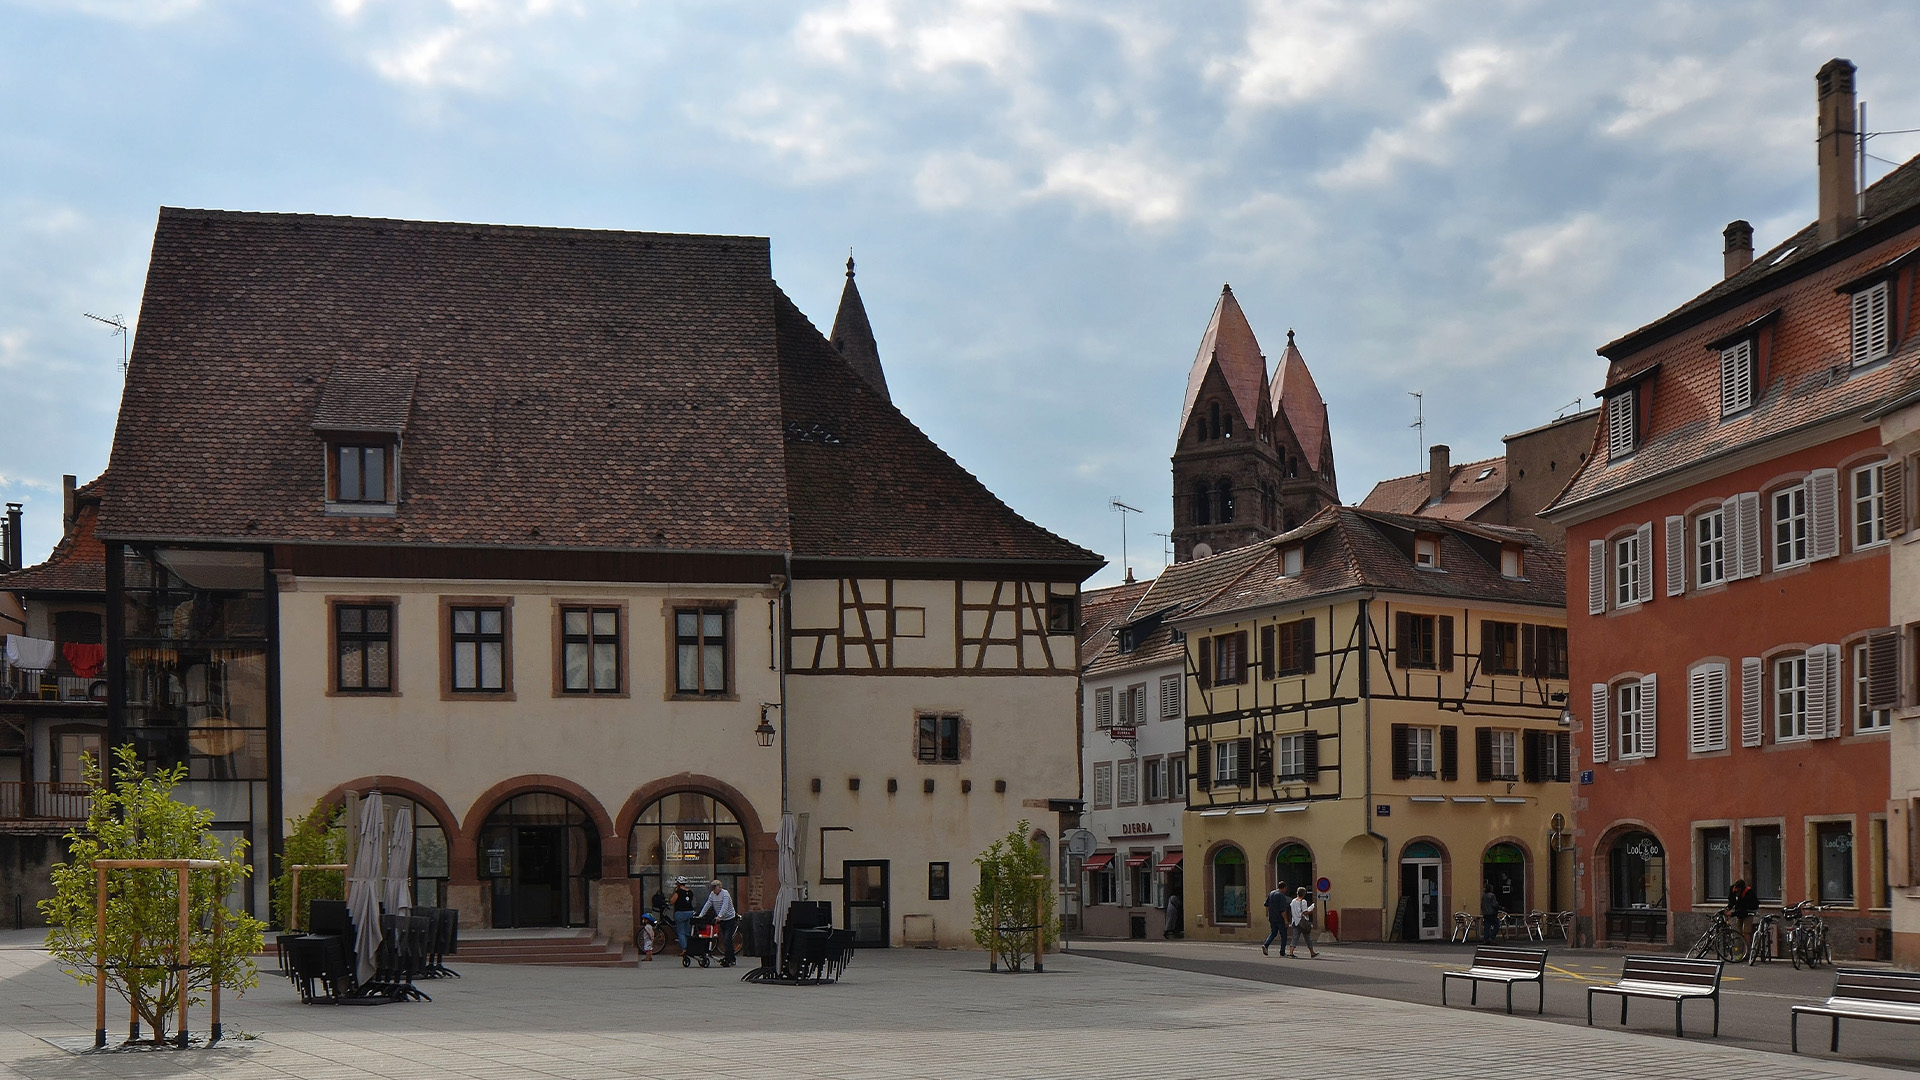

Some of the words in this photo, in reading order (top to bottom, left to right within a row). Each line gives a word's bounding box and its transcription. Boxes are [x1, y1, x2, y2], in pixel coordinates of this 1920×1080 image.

[1122, 822, 1153, 834] DJERBA
[684, 832, 709, 841] MAISON
[684, 841, 692, 849] DU
[694, 841, 709, 849] PAIN
